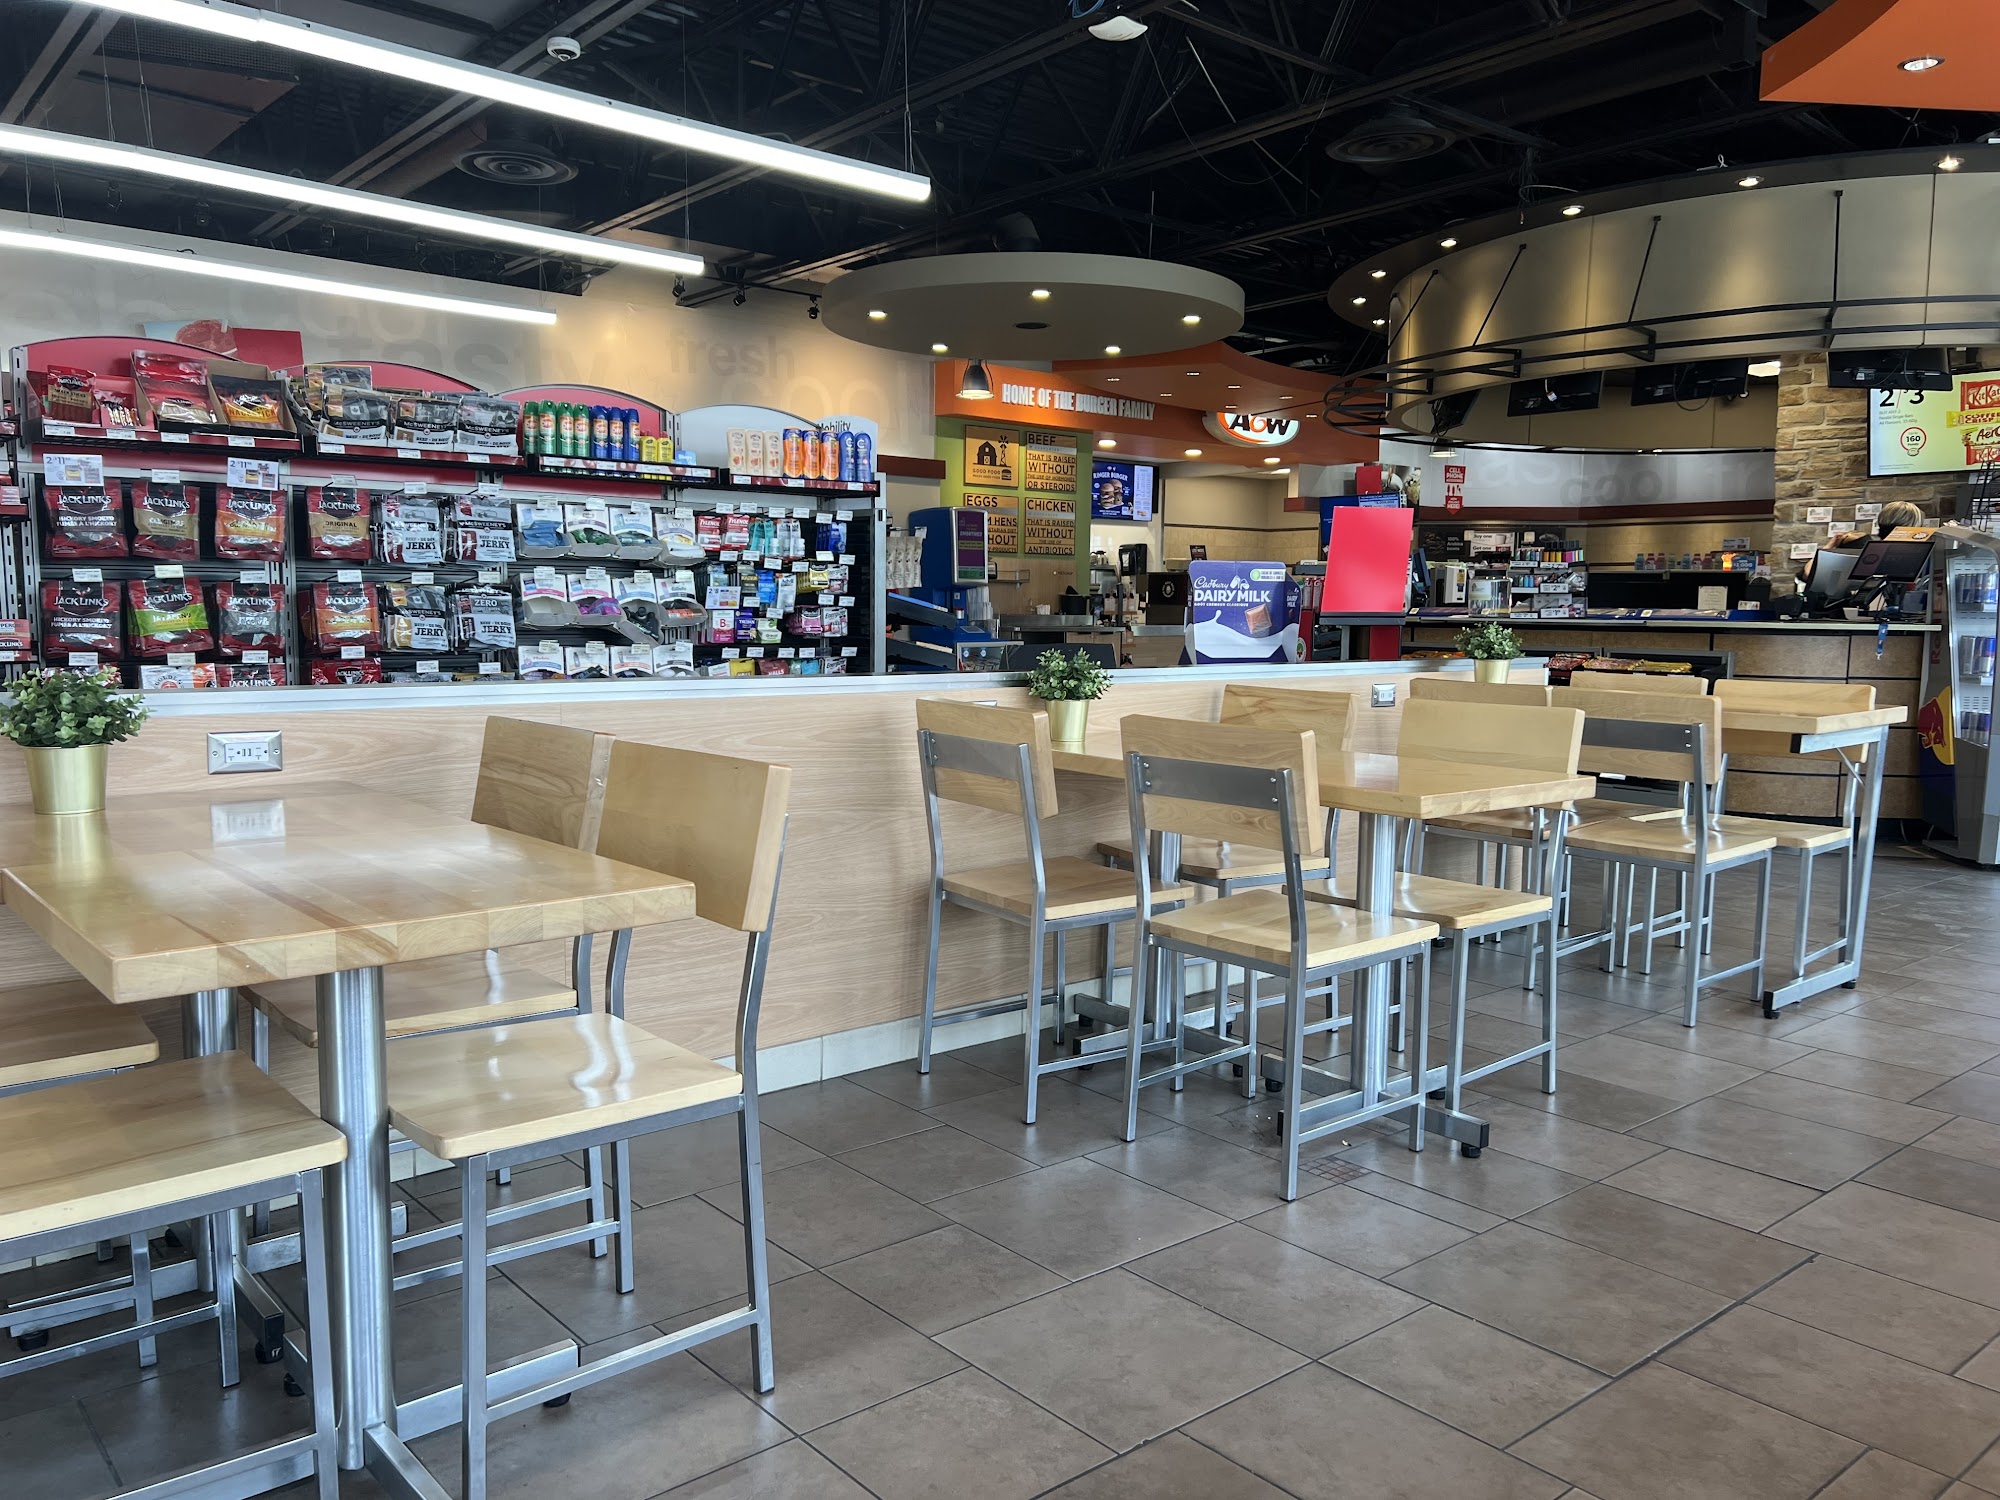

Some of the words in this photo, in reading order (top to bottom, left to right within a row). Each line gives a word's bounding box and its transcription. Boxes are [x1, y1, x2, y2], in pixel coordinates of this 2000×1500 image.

[667, 334, 796, 378] fresh
[1002, 383, 1035, 406] HOME
[1038, 388, 1052, 408] OF
[1053, 390, 1075, 410] THE
[1076, 394, 1118, 416] BURGER
[1118, 399, 1156, 420] FAMILY
[818, 420, 852, 433] Mobility
[1028, 434, 1056, 446] BEEF
[1054, 456, 1076, 464] RAISED
[1028, 462, 1074, 475] WITHOUT
[1028, 480, 1038, 488] OR
[1040, 482, 1075, 492] STEROIDS
[57, 494, 82, 504] JACK
[143, 496, 165, 507] JACK
[226, 500, 248, 508] JACK
[966, 496, 998, 508] EGGS
[318, 500, 338, 510] JACK
[1028, 500, 1074, 512] CHICKEN
[994, 517, 1017, 526] HENS
[1027, 528, 1074, 538] WITHOUT
[480, 540, 510, 549] JERKY
[988, 535, 1016, 546] HOUT
[406, 542, 436, 550] JERKY
[1028, 546, 1072, 554] ANTIBIOTICS
[1194, 576, 1230, 590] Cadbury
[54, 596, 80, 606] JACK
[143, 595, 166, 605] JACK
[228, 596, 251, 606] JACK
[1194, 590, 1236, 602] DAIRY
[1236, 590, 1272, 602] MILK
[414, 628, 444, 636] JERKY
[482, 625, 512, 634] JERKY
